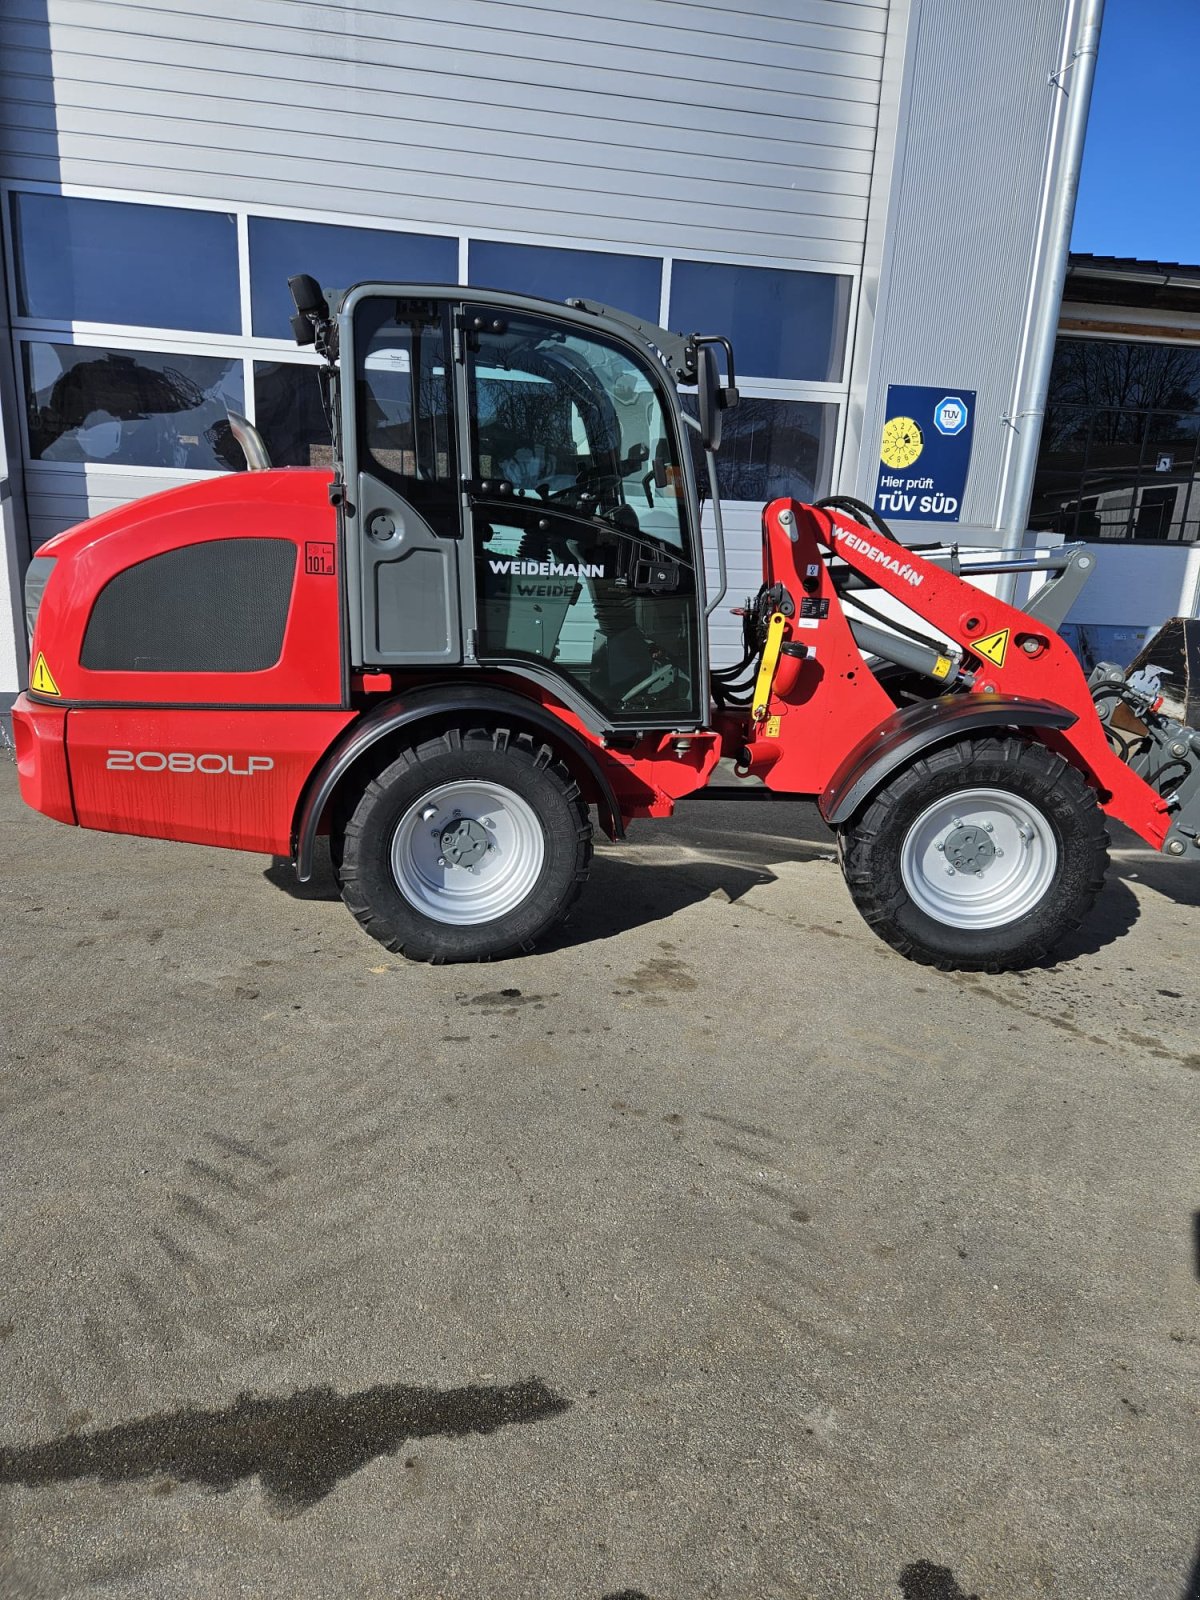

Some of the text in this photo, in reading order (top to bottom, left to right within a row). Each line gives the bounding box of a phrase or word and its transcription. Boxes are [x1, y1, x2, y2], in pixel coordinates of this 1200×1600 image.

[881, 476, 934, 491] Hier prüft
[879, 490, 958, 514] TÜV SÜD
[308, 556, 325, 573] 101
[832, 523, 924, 586] WEIDEMANN
[488, 560, 604, 578] WEIDEMANN
[106, 750, 274, 776] 2080LP
